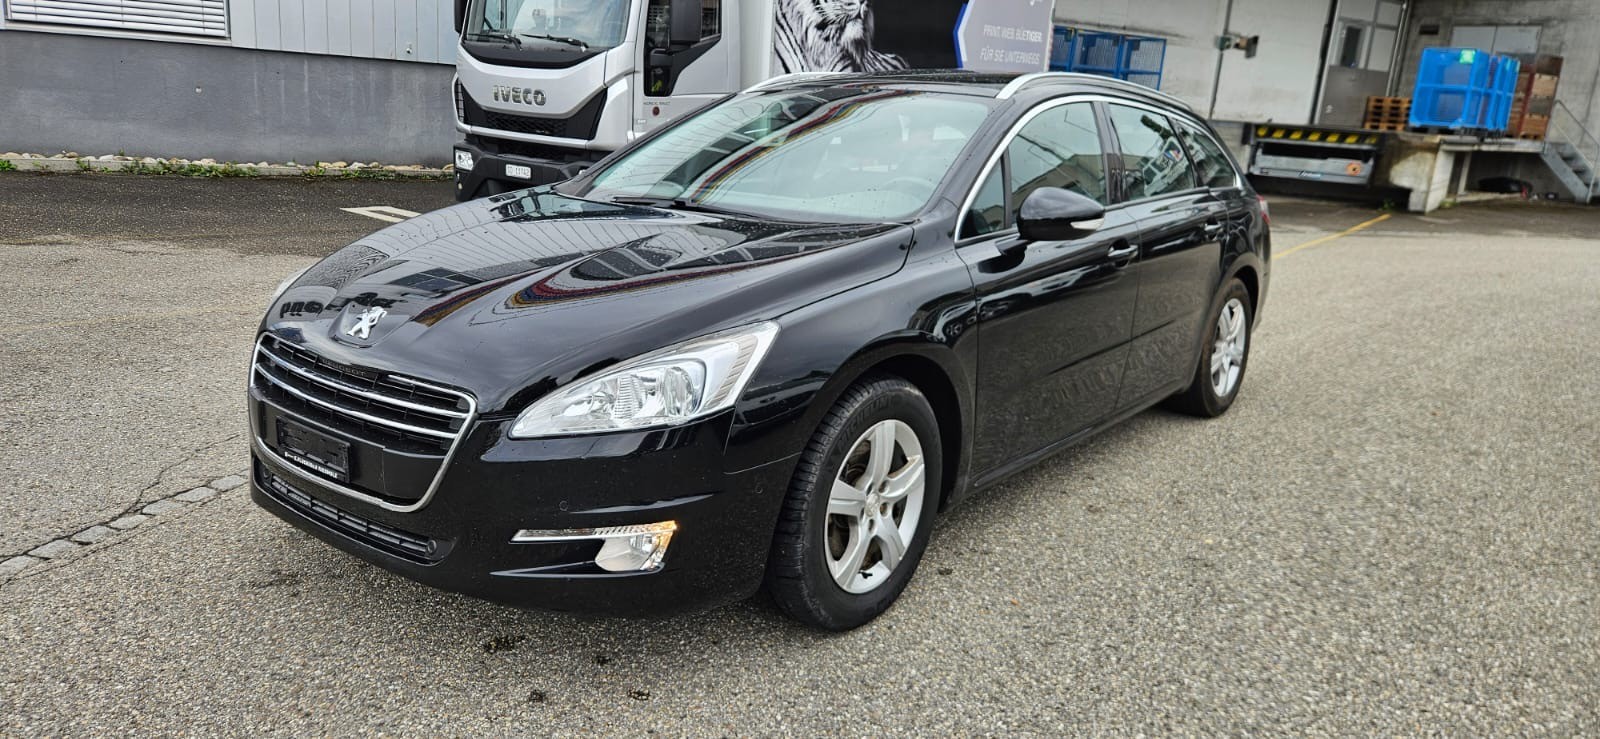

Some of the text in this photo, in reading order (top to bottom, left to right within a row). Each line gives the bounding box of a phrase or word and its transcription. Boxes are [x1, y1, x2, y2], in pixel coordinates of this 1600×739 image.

[983, 24, 1001, 38] PRINT
[1001, 27, 1015, 40] WEB
[981, 44, 1040, 65] FÜR SIE UNTERWEGS
[493, 85, 546, 106] IVECO
